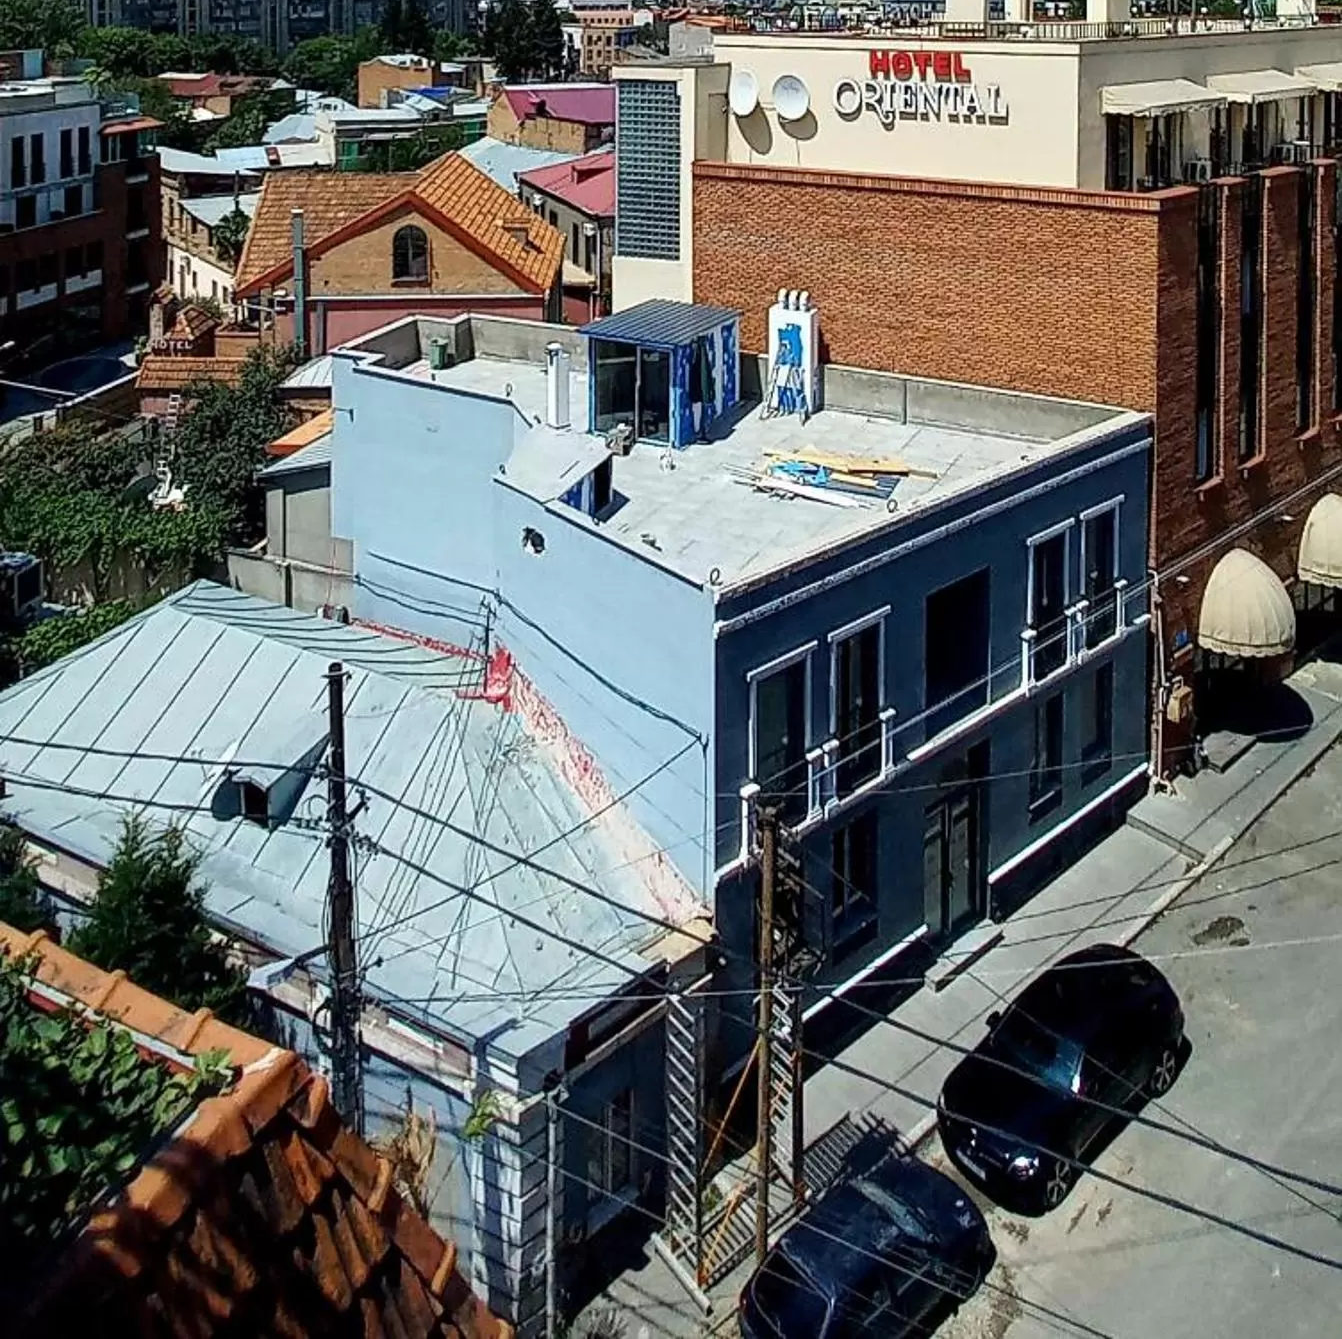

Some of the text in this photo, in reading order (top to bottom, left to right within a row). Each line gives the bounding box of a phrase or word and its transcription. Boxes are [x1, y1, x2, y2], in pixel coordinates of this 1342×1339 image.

[869, 49, 971, 80] HOTEL
[833, 79, 1009, 128] ORIENTAL
[149, 338, 193, 350] HOTEL
